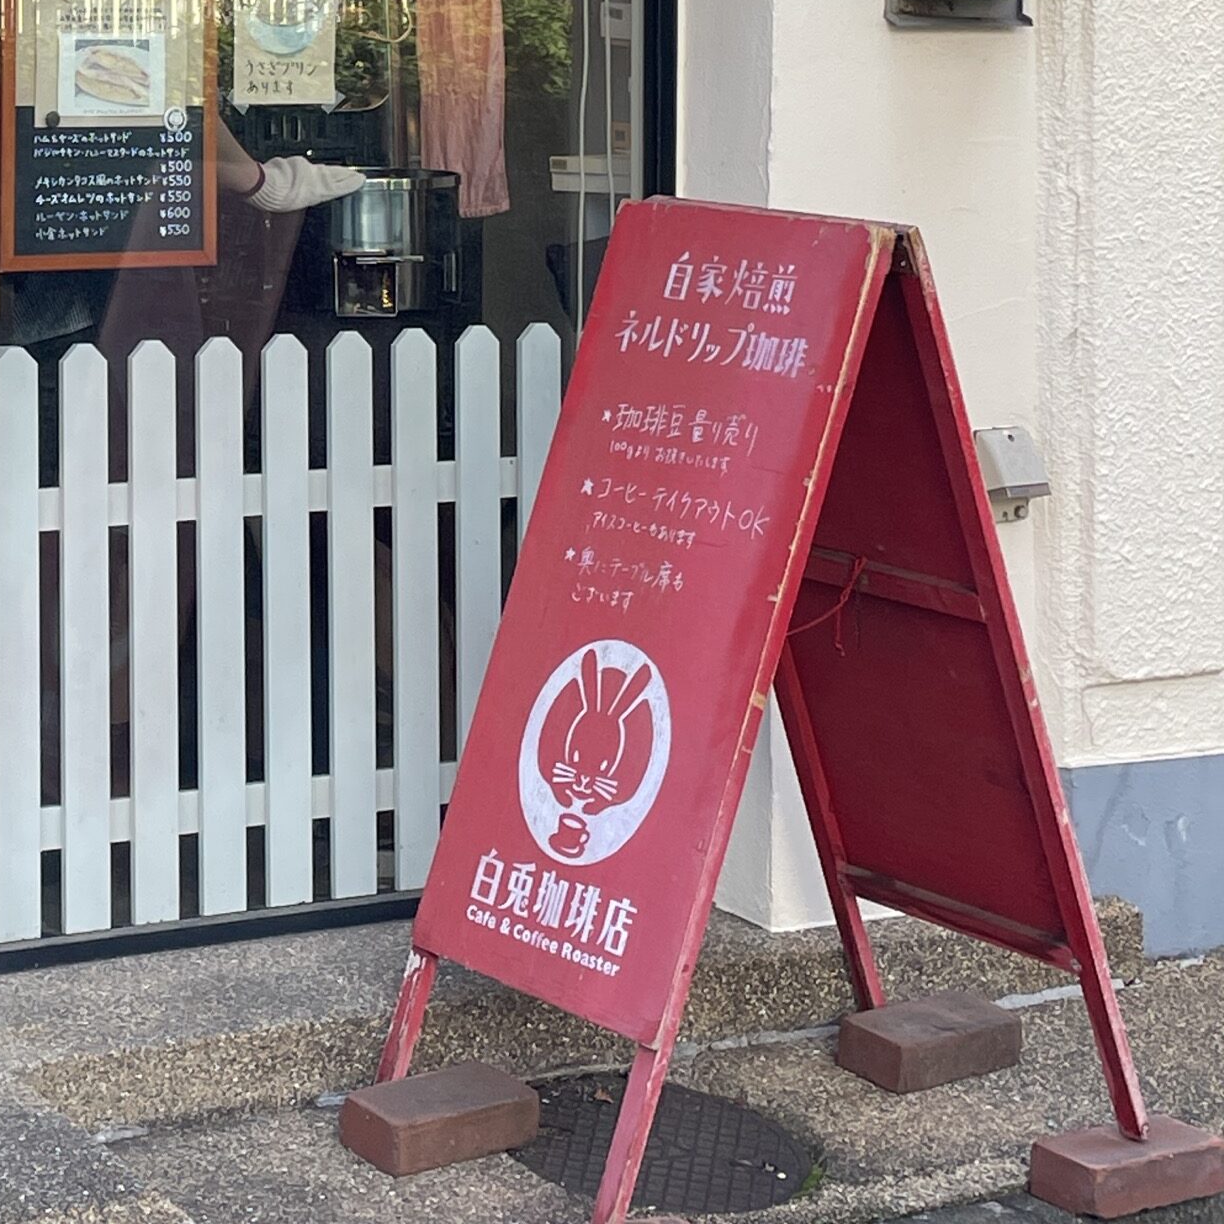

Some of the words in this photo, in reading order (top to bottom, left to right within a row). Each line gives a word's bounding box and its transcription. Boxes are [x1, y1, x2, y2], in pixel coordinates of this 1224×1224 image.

[246, 60, 318, 76] うさぎプリン
[247, 80, 293, 95] あります
[663, 251, 798, 316] 自家焙煎
[614, 310, 810, 379] ネルドリップ珈琲
[612, 403, 759, 457] 珈琲豆量り売り
[592, 511, 696, 550] アイスコーヒーもあります
[578, 545, 685, 594] 奥にテーブル席も
[466, 905, 496, 930] Cafe
[499, 917, 511, 936] &
[513, 924, 559, 955] Coffee
[561, 942, 621, 977] Roaster
